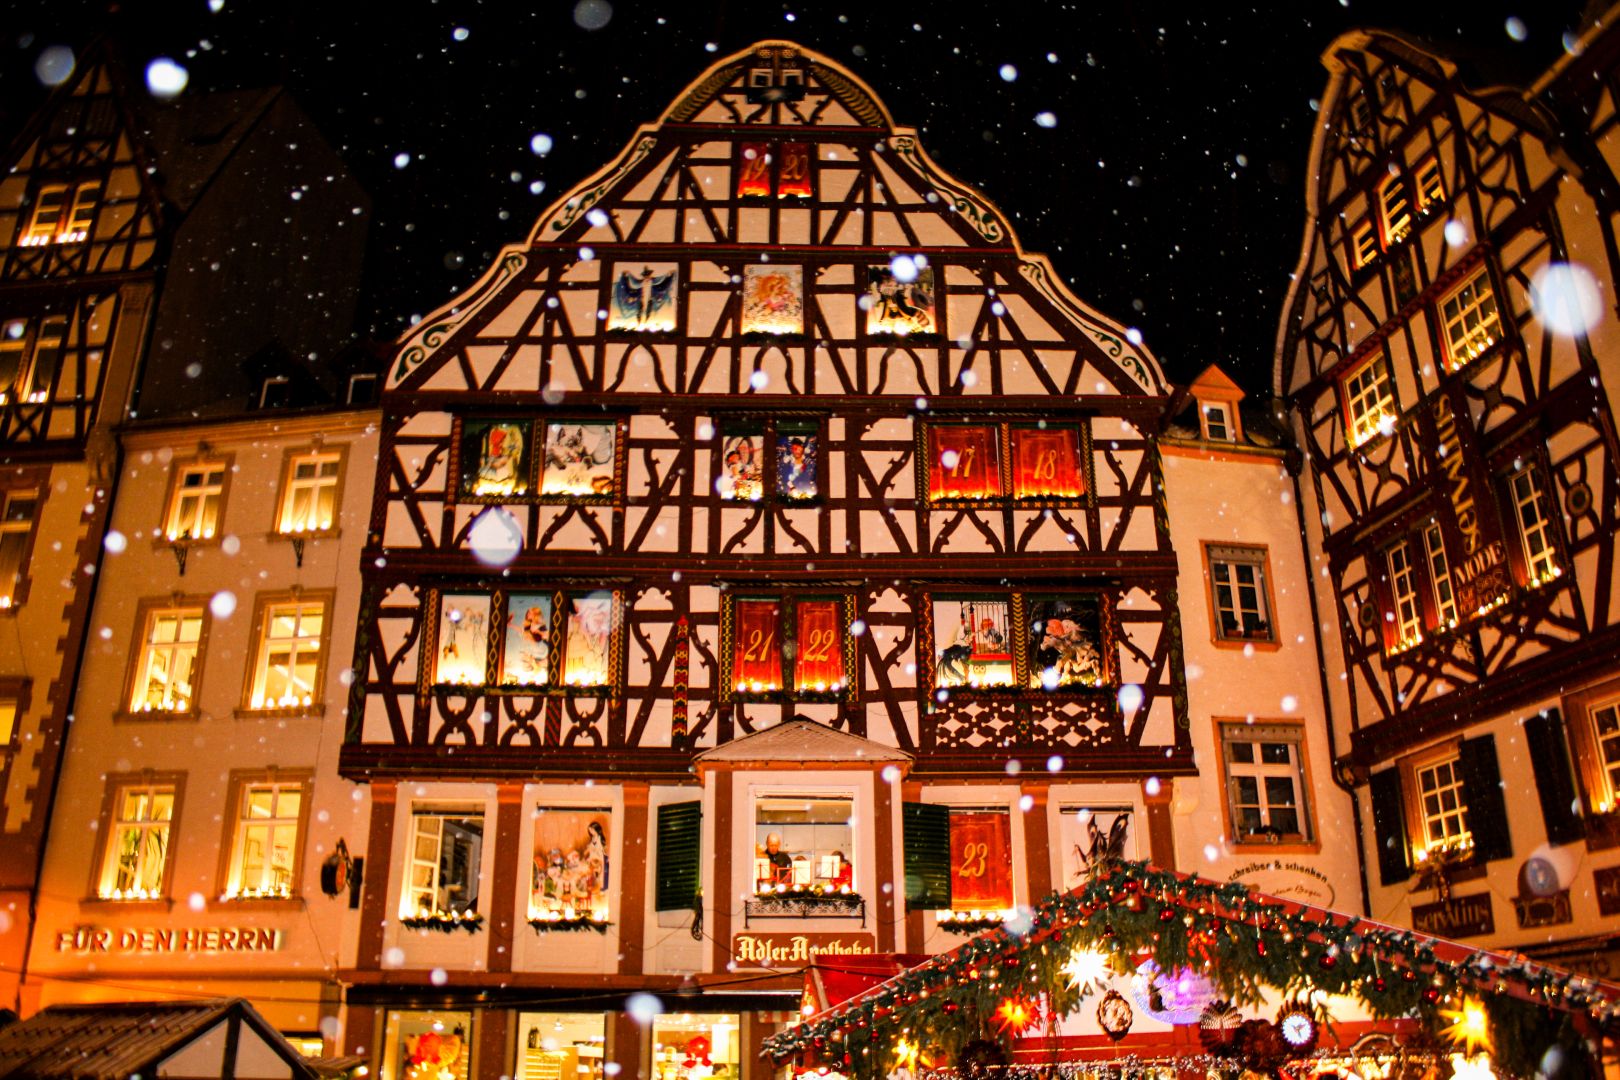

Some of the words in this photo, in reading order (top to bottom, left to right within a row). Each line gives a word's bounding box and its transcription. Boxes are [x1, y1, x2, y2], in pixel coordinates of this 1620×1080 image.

[781, 154, 808, 180] 20
[951, 448, 975, 478] 17
[1033, 449, 1057, 480] 18
[1454, 540, 1506, 586] MODE
[743, 629, 774, 662] 21
[803, 629, 835, 662] 22
[959, 842, 988, 878] 23
[56, 924, 111, 954] FÜR
[118, 927, 176, 954] DEN
[180, 927, 281, 954] HERRN
[735, 936, 790, 962] Adler
